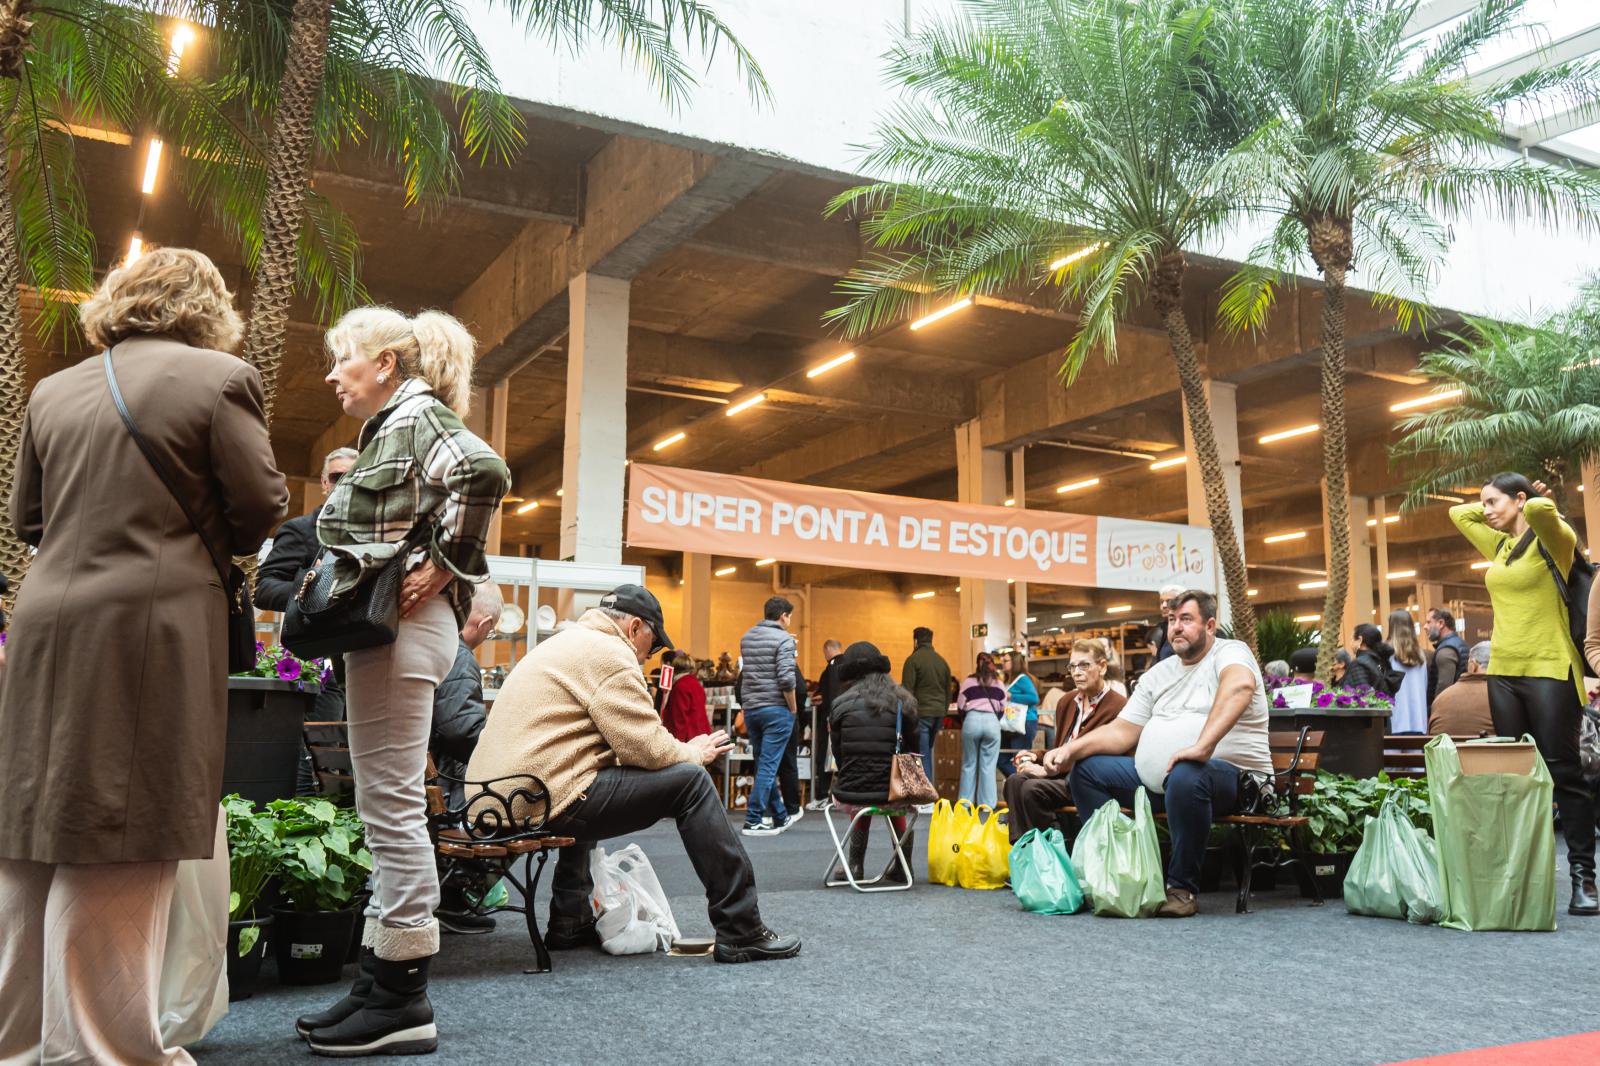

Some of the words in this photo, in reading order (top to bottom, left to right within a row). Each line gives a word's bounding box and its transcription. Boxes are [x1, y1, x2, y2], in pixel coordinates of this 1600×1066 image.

[641, 486, 762, 534] SUPER
[771, 502, 889, 547] PONTA
[898, 516, 942, 552] DE
[949, 521, 1088, 571] ESTOQUE
